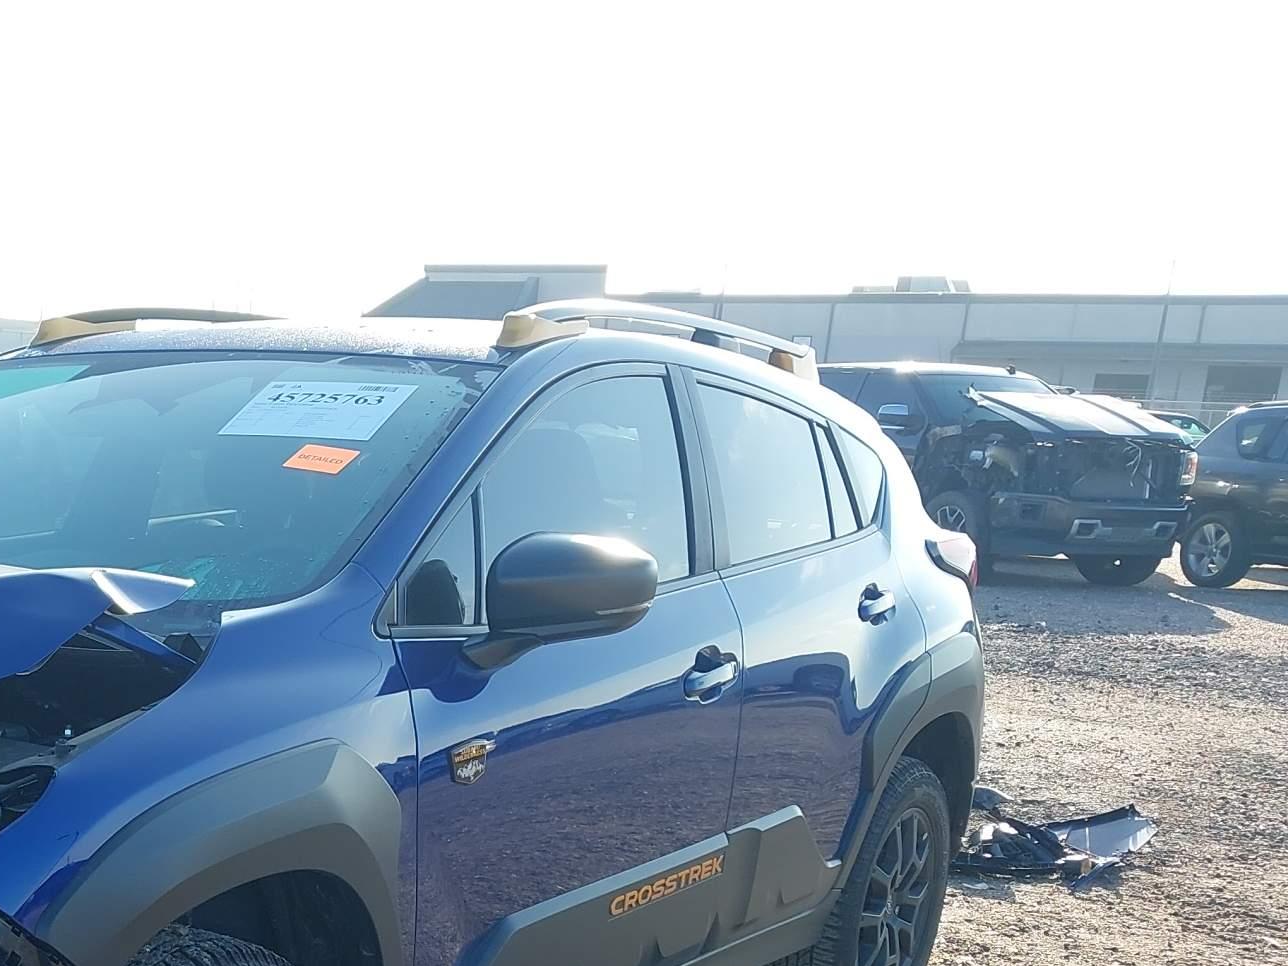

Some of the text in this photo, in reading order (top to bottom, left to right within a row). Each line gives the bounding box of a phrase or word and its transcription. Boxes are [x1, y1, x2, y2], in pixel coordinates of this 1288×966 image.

[267, 392, 385, 406] 45725763
[297, 453, 344, 465] DETAILED
[609, 855, 725, 917] CROSSTREK
